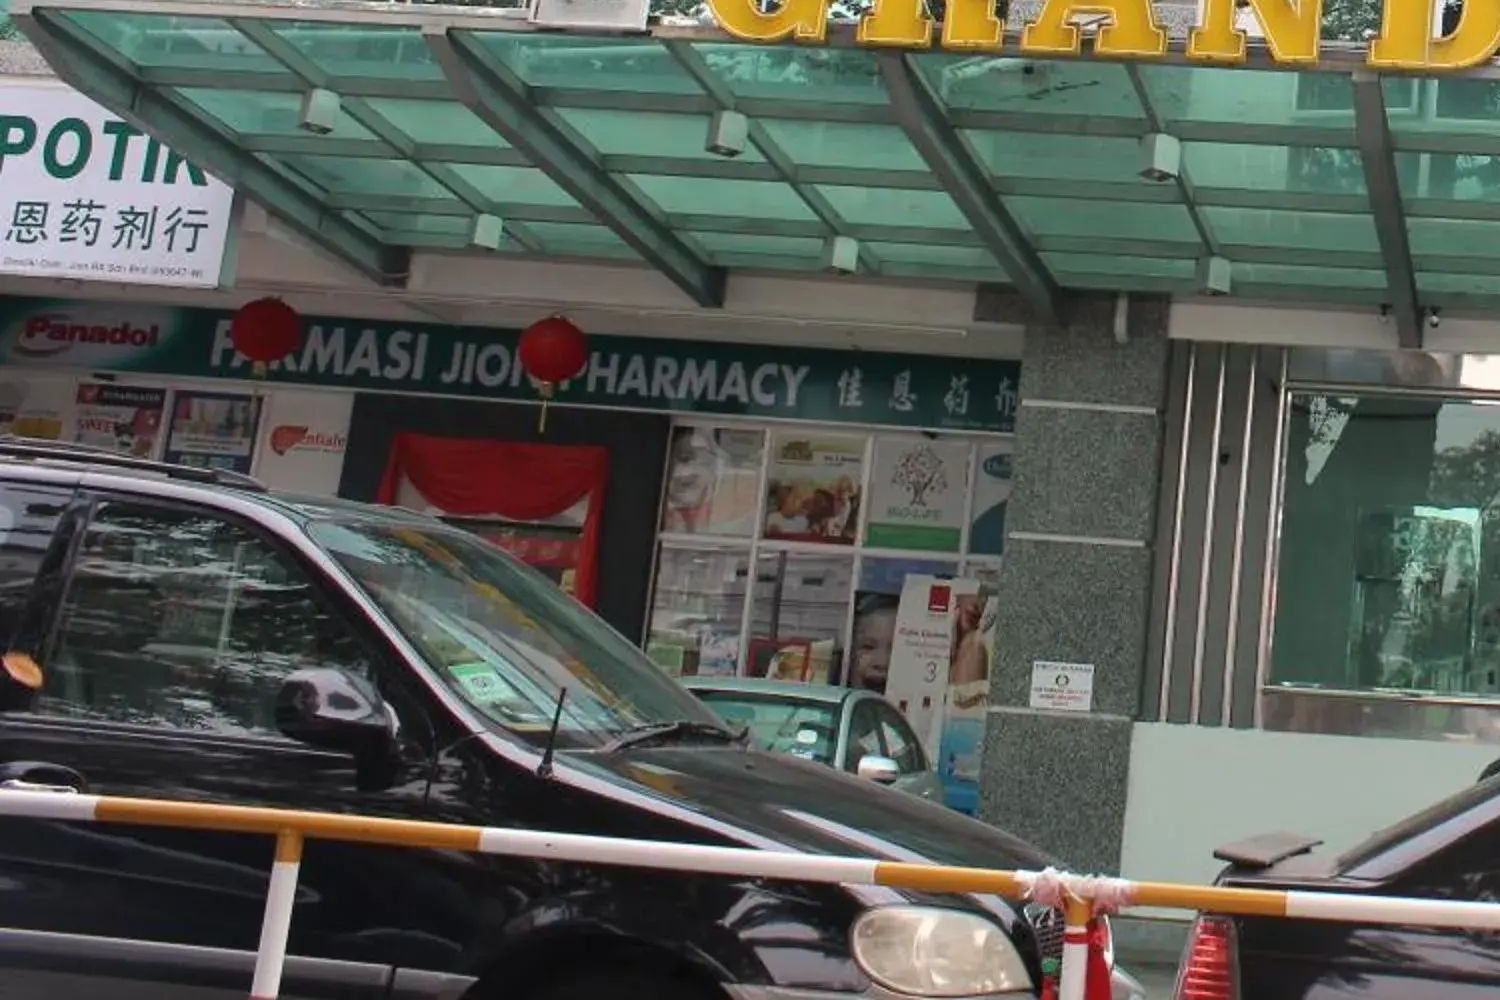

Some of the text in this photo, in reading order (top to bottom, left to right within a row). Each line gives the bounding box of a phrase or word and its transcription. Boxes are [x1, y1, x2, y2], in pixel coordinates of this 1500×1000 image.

[6, 198, 209, 253] 恩药剂行
[23, 315, 158, 347] Panadol
[560, 350, 810, 407] HARMACY
